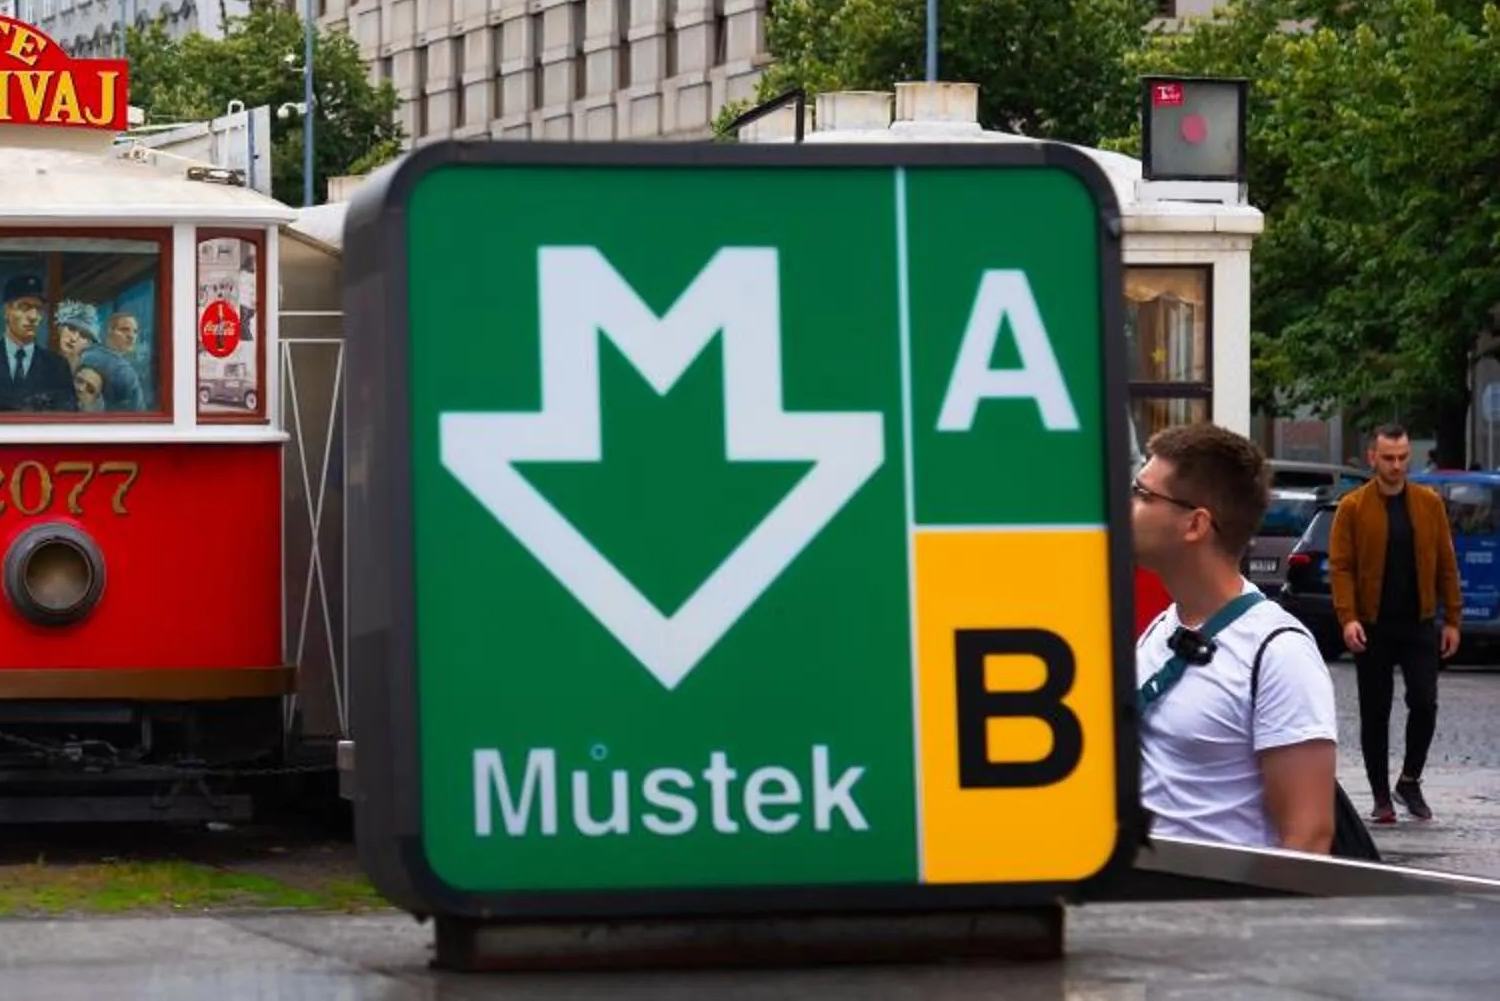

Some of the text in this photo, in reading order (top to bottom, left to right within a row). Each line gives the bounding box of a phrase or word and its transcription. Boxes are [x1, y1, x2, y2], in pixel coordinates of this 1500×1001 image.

[936, 269, 1081, 431] A
[472, 743, 869, 837] Můstek
[954, 628, 1085, 791] B
